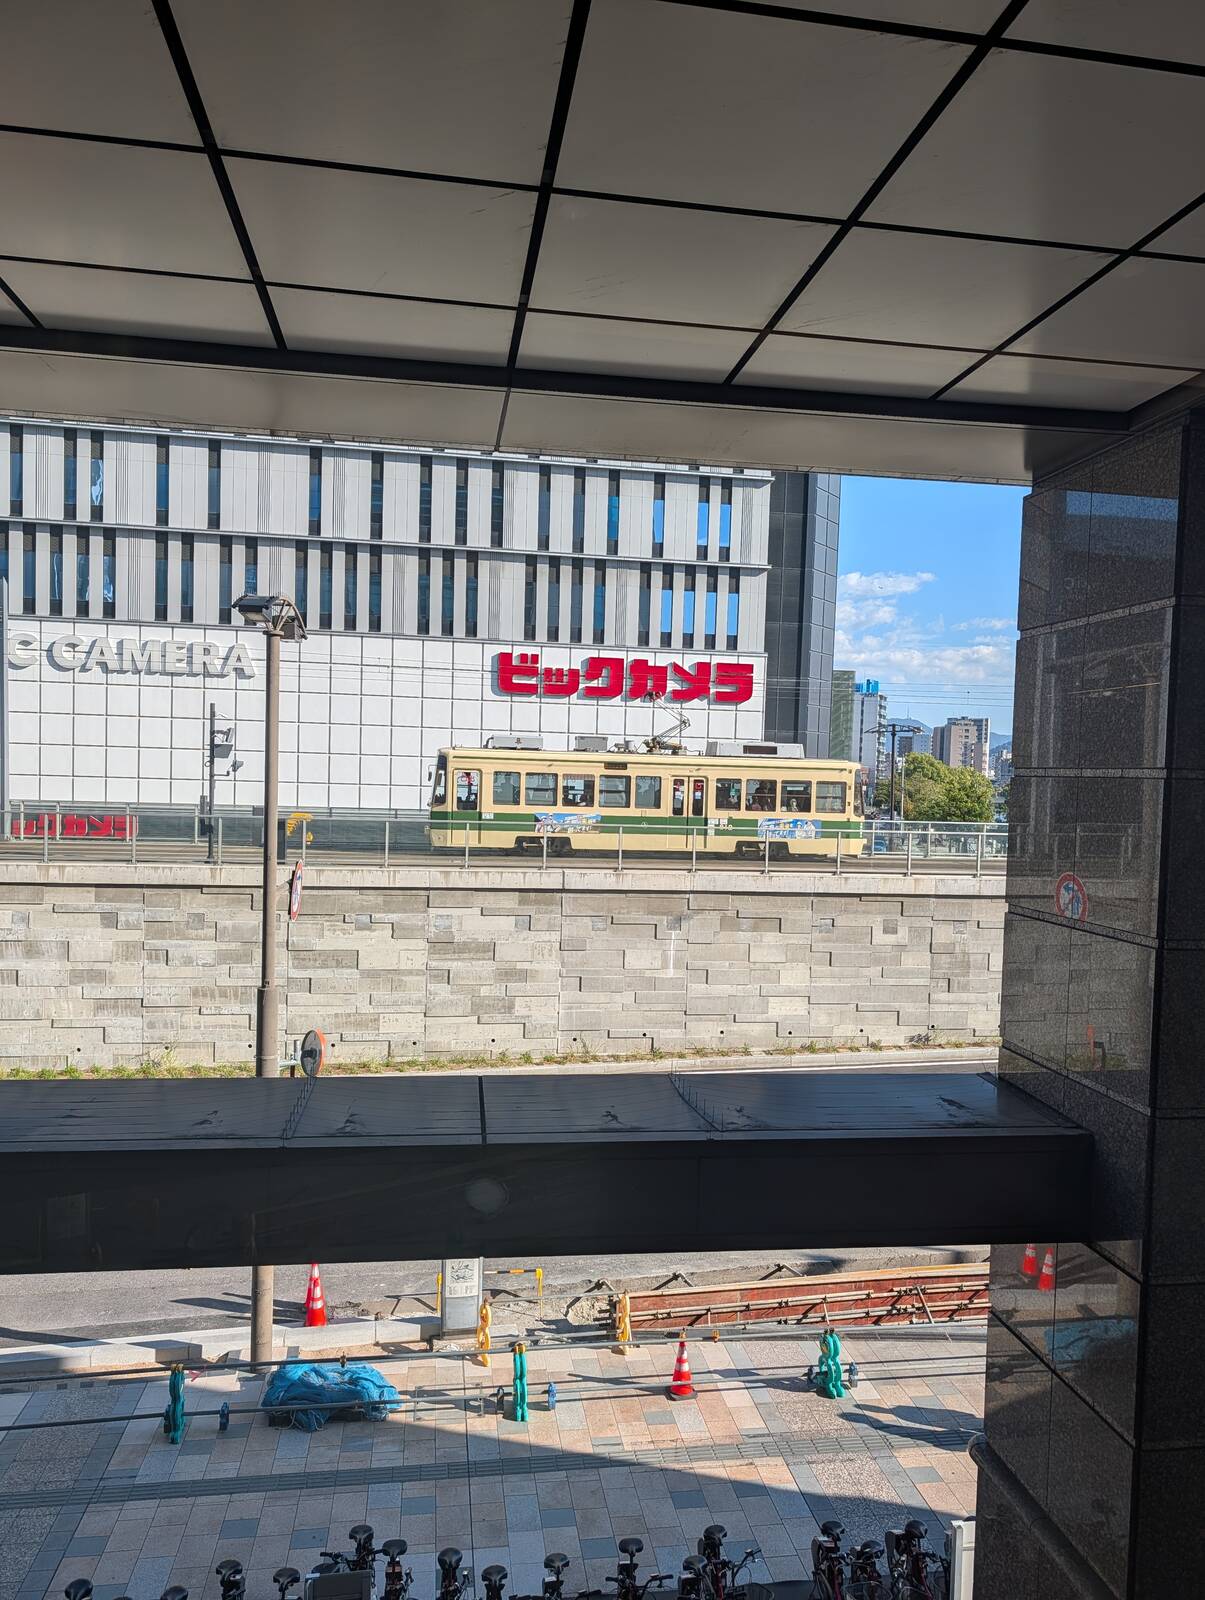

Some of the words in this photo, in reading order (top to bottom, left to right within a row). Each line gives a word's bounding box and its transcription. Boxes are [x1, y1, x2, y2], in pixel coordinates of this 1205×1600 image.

[50, 634, 256, 678] CAMERA
[496, 651, 755, 704] ビックカメラ
